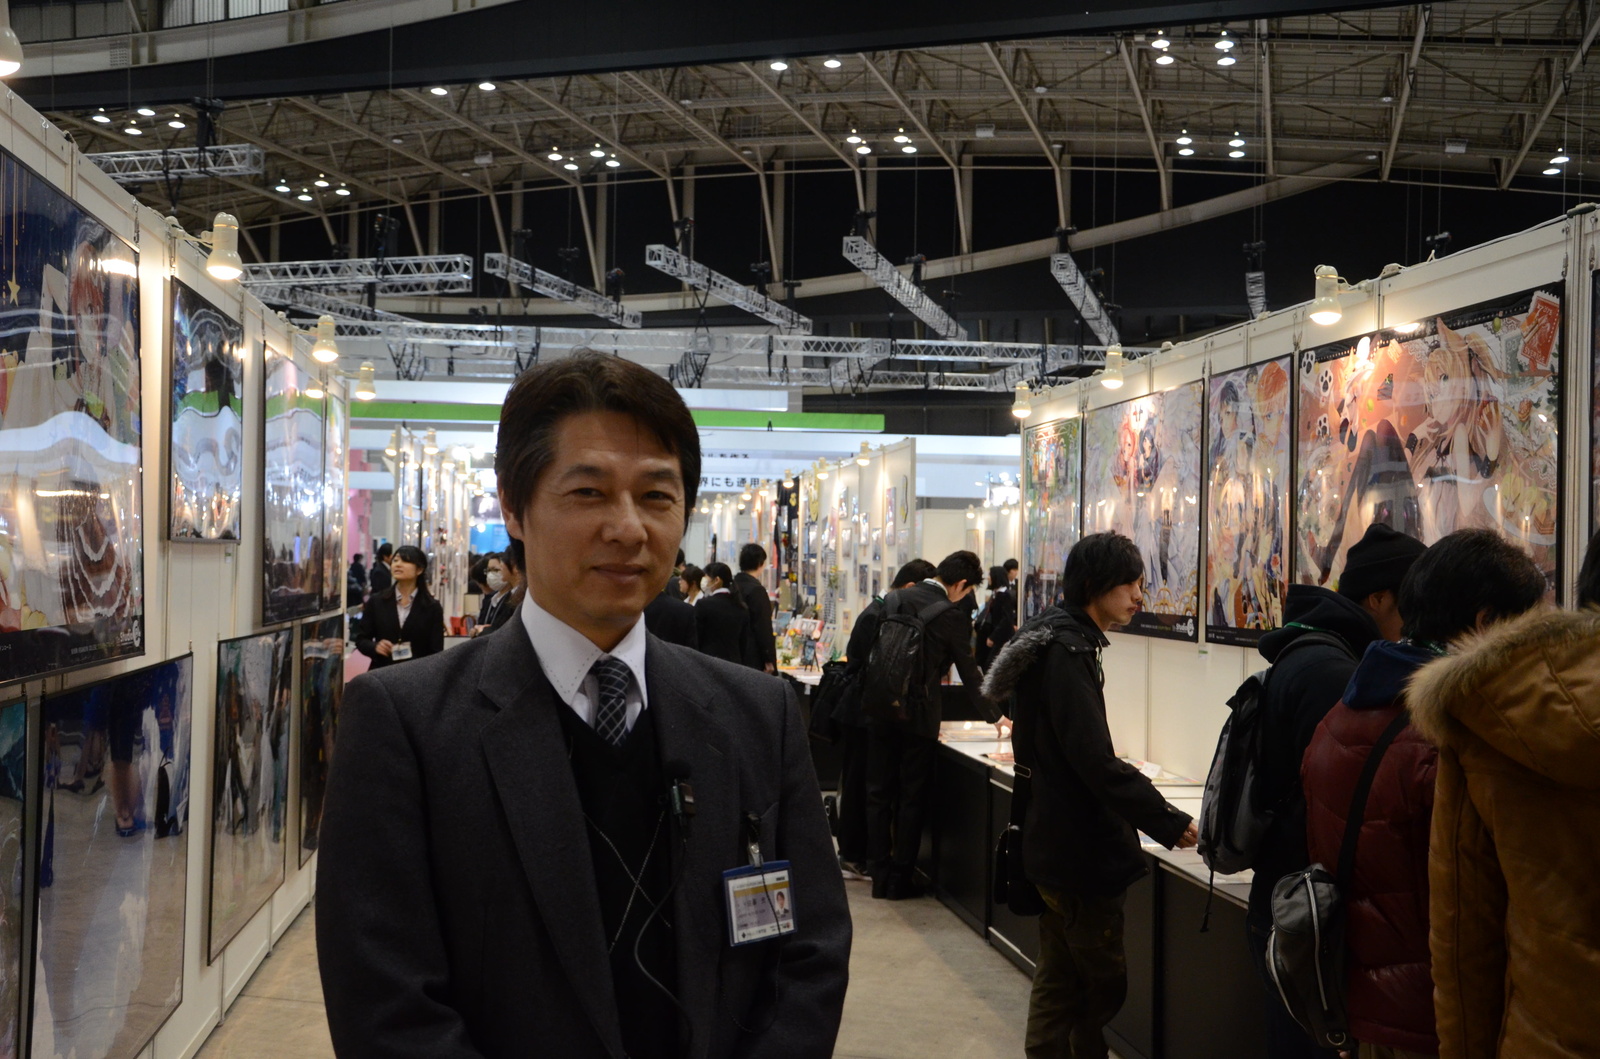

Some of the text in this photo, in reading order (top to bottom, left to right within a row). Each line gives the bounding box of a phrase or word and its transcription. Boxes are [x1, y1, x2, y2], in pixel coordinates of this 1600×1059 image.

[1523, 347, 1546, 363] SVERIGE
[700, 477, 772, 488] 界にも通用
